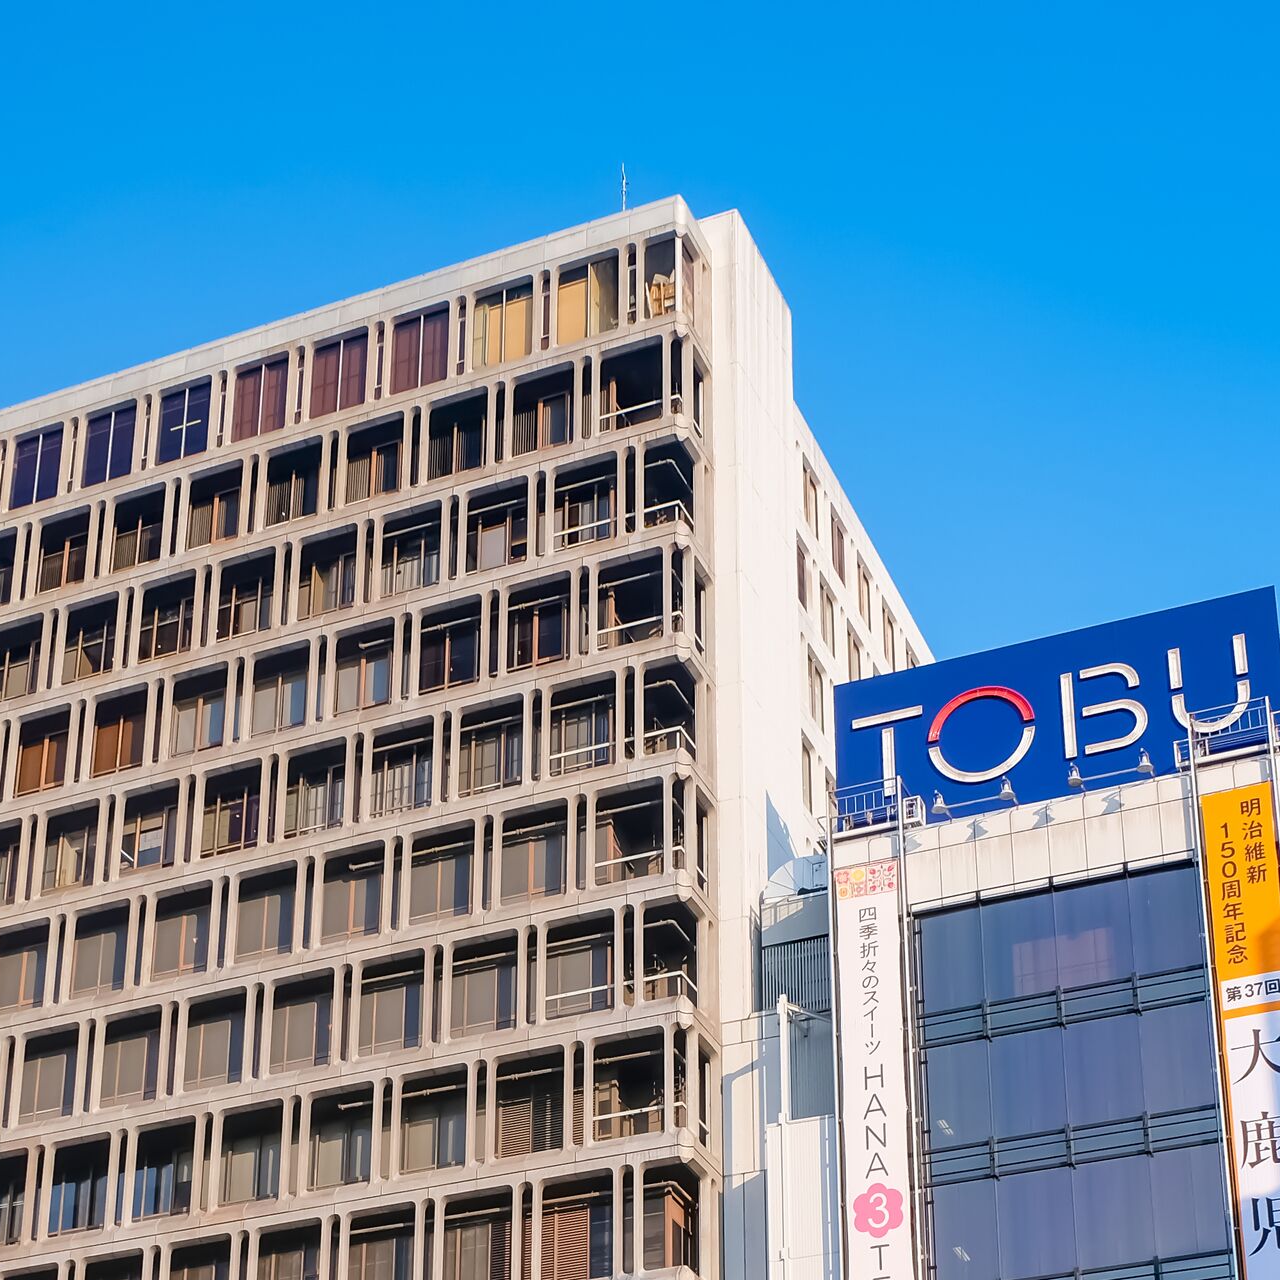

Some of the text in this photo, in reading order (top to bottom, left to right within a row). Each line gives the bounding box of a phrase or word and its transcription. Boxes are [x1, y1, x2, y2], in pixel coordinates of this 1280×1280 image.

[851, 633, 1251, 798] TOBU
[1219, 822, 1249, 965] 150周年記念
[1239, 797, 1268, 884] 明治維新
[857, 906, 882, 1057] 四季折々のスイーツ
[862, 1066, 890, 1177] HANA
[867, 1191, 889, 1231] 3
